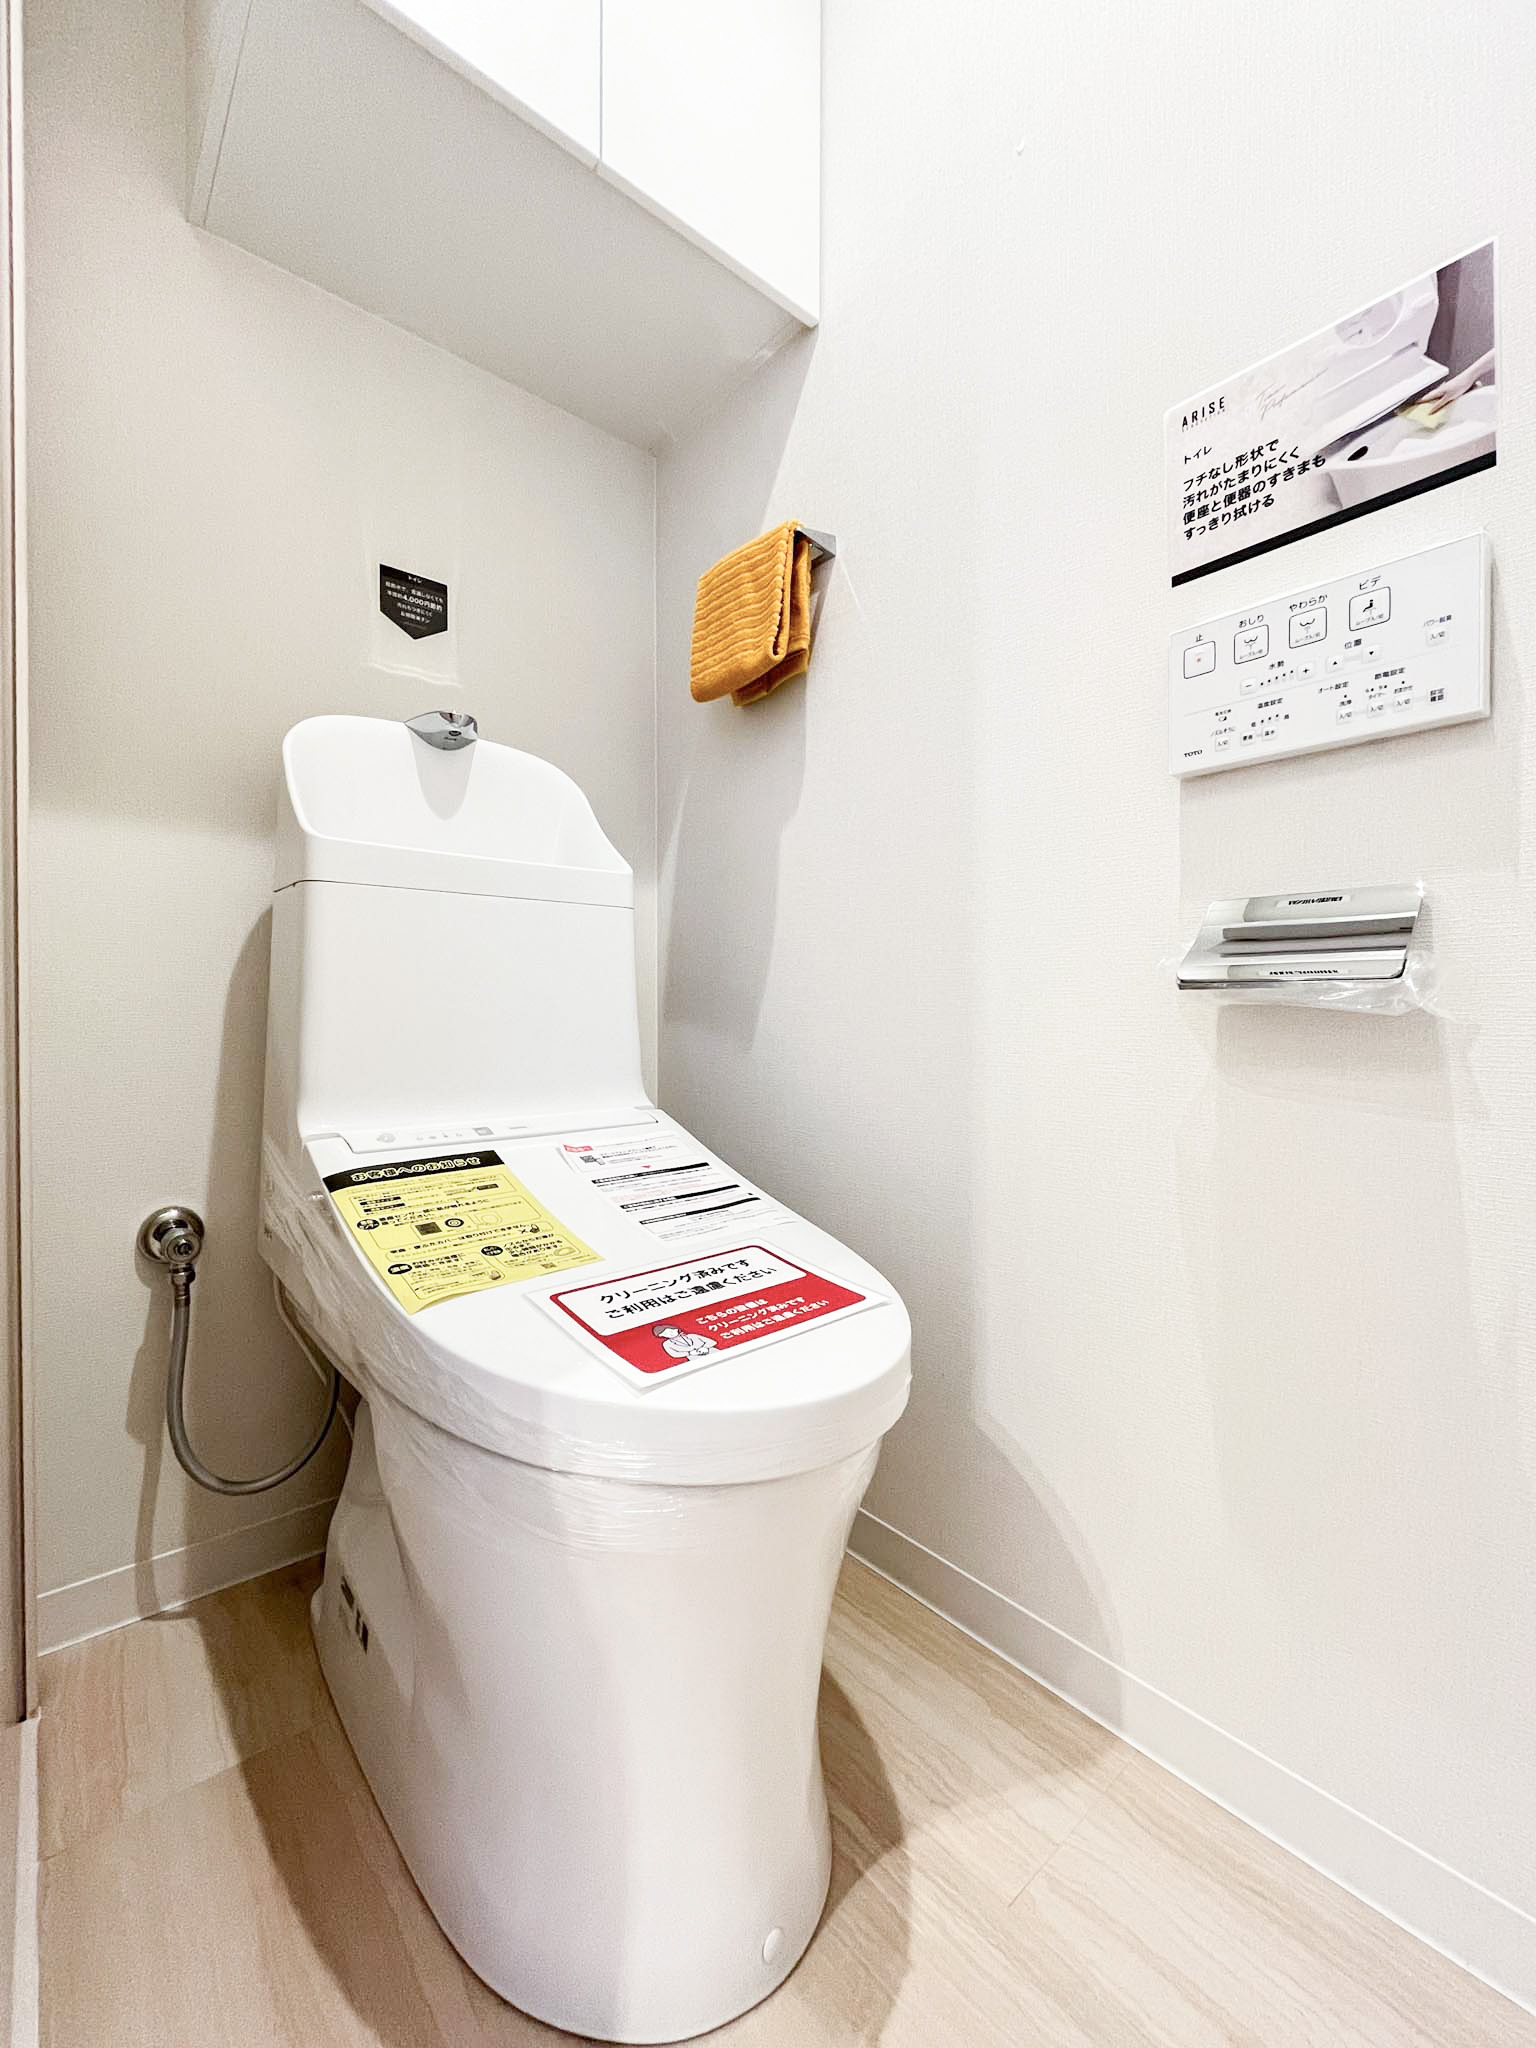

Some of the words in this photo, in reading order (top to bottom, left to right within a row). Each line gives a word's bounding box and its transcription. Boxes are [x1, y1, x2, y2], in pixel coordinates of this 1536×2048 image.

[1182, 396, 1225, 428] ARISE
[1183, 438, 1279, 492] フチなし形状で
[1184, 445, 1212, 465] トイレ
[1182, 446, 1300, 509] 汚れがたまりにくく
[1182, 454, 1327, 525] 便座と便器のすきまも
[1183, 494, 1275, 541] すっきり拭ける
[1359, 575, 1382, 590] ビデ
[1289, 594, 1328, 612] やわらか
[1195, 633, 1203, 643] 止
[1239, 615, 1264, 628] おしり
[1184, 749, 1203, 758] TOTO
[351, 1157, 480, 1182] お客様へのお知らせ
[600, 1258, 750, 1304] クリーニング済みです
[604, 1267, 777, 1319] ご利用はご遠慮ください
[708, 1297, 805, 1332] クリーニング済みです
[720, 1300, 830, 1339] ご利用はご遠慮ください
